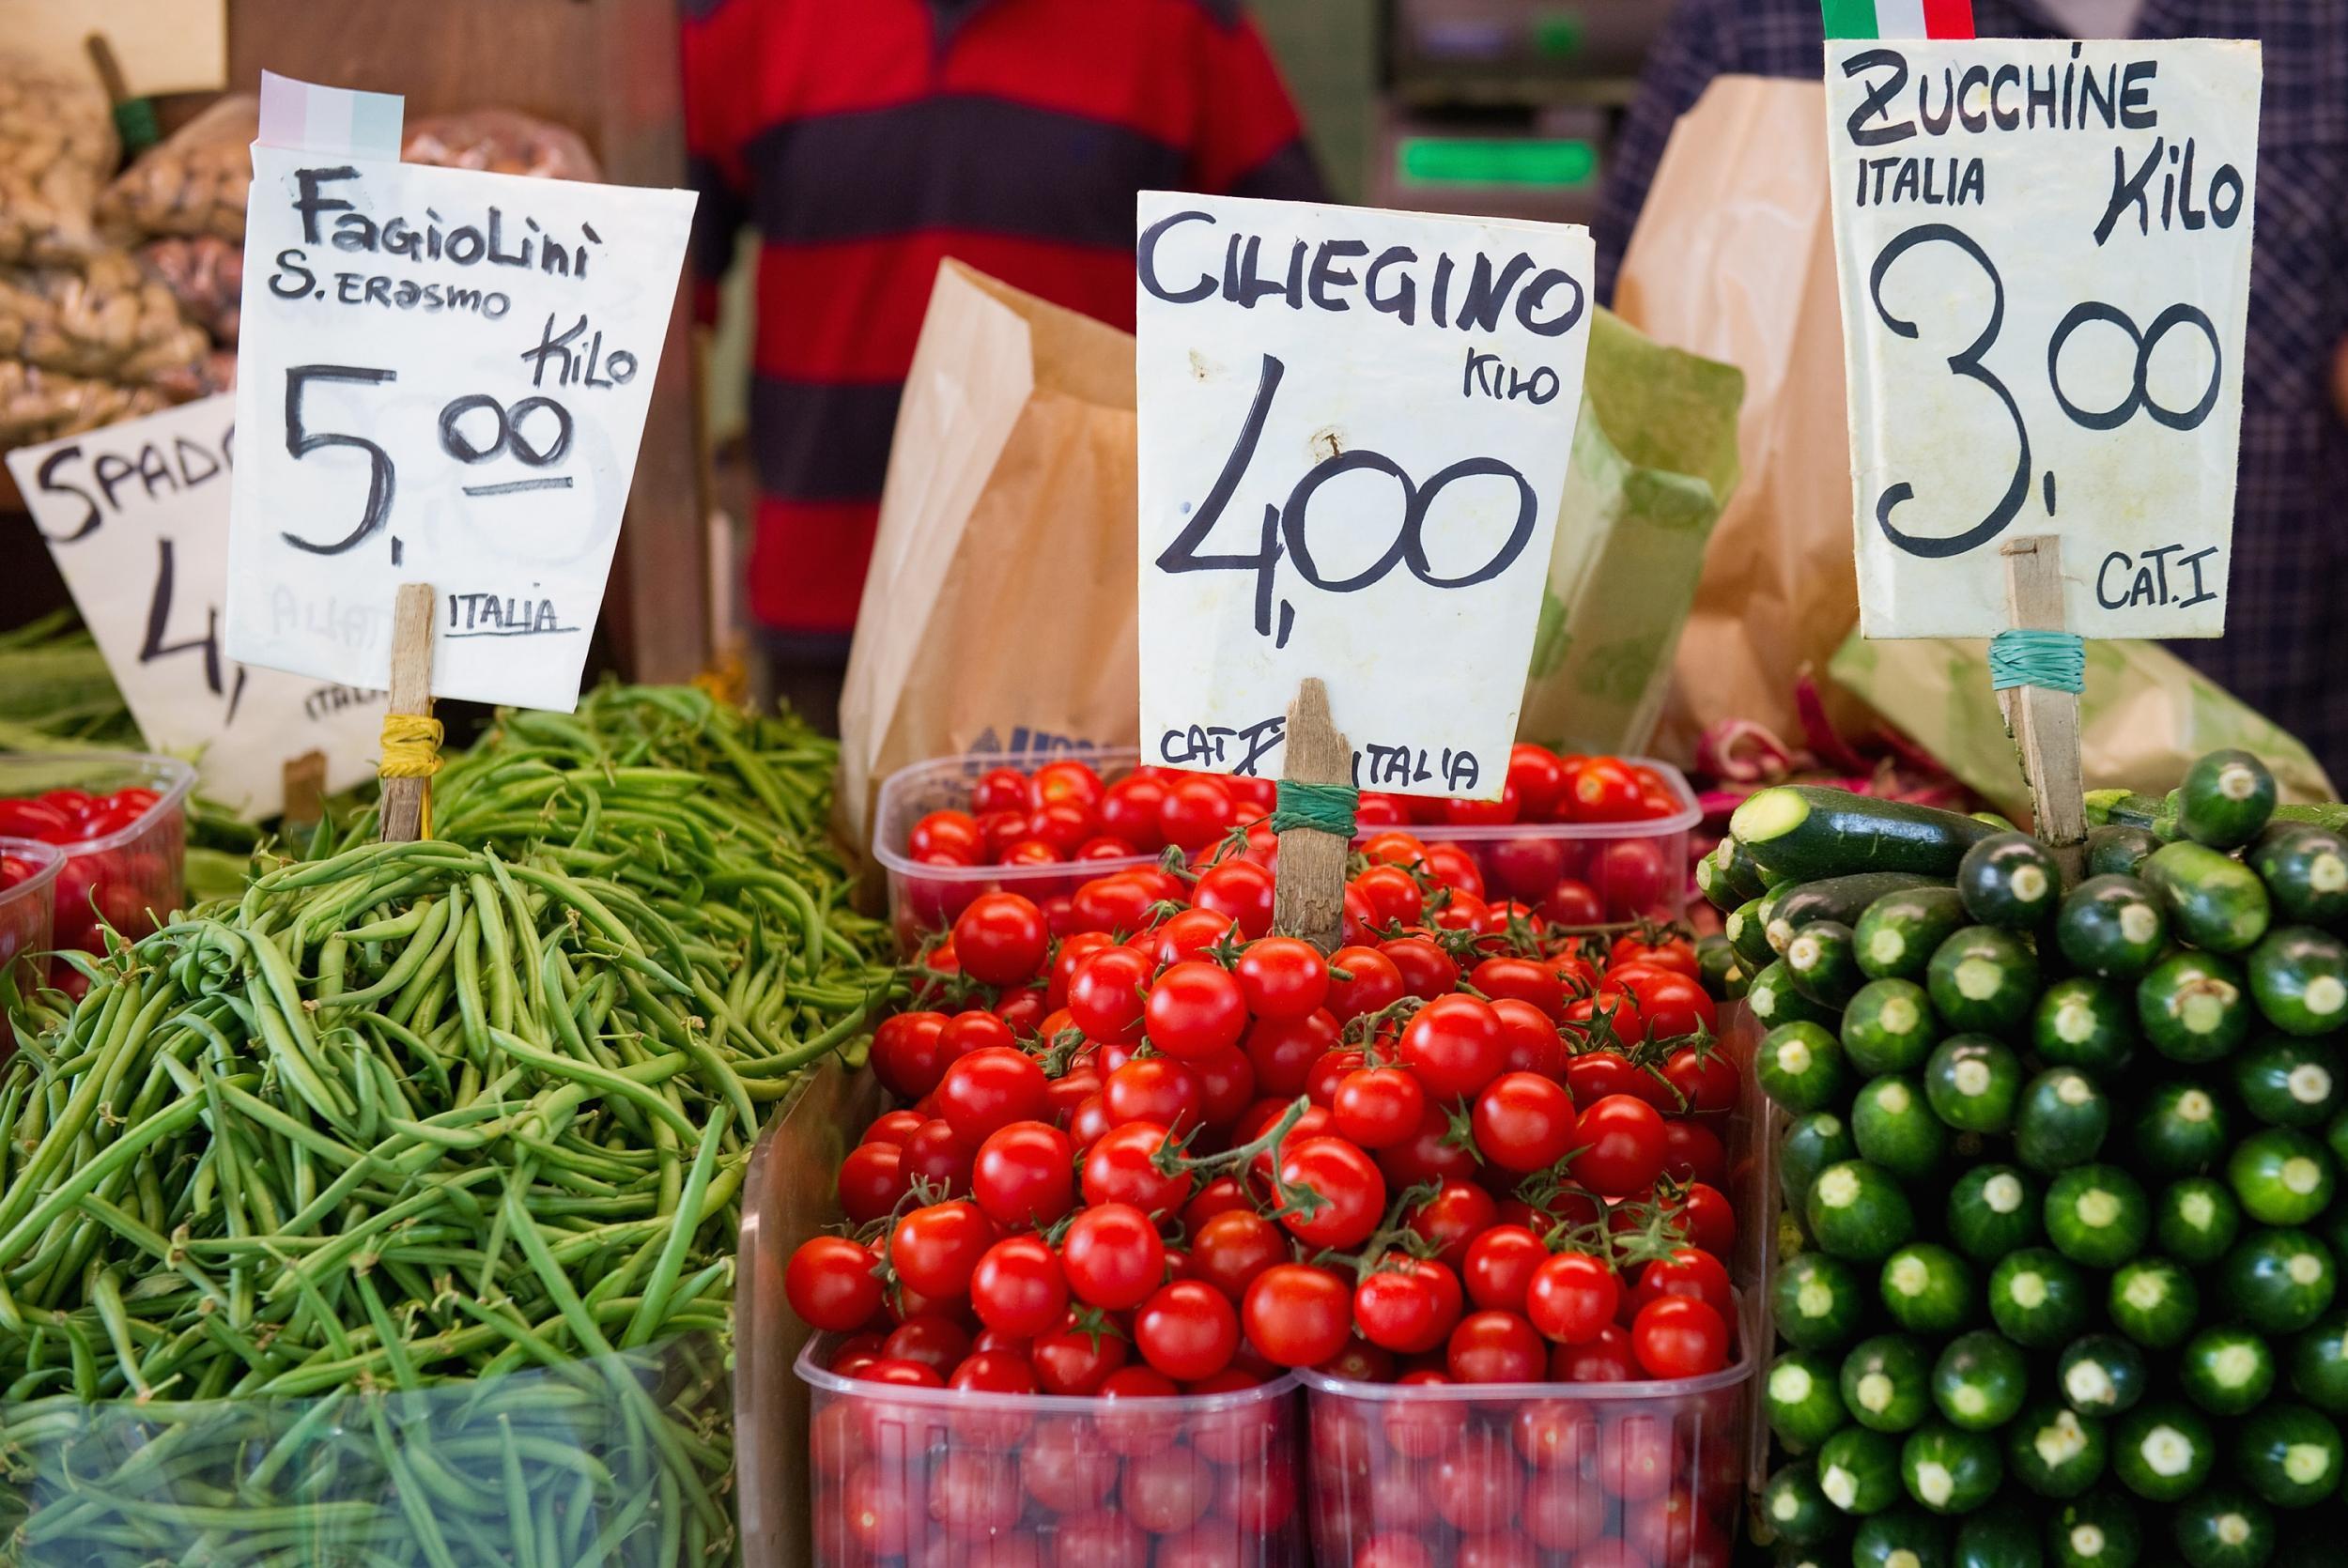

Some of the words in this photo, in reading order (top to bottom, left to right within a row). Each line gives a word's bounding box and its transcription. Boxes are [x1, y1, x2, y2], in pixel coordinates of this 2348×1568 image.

[1842, 41, 2158, 146] ZUCCHINE
[1856, 156, 1985, 207] ITALIA
[268, 248, 325, 300] S.
[1137, 209, 1584, 337] CILIEGINO
[1463, 346, 1560, 406] KILO
[1869, 223, 2222, 559] 3,00
[1155, 352, 1538, 650] 4,00
[446, 582, 564, 636] ITALIA
[1352, 733, 1479, 792] ITALIA
